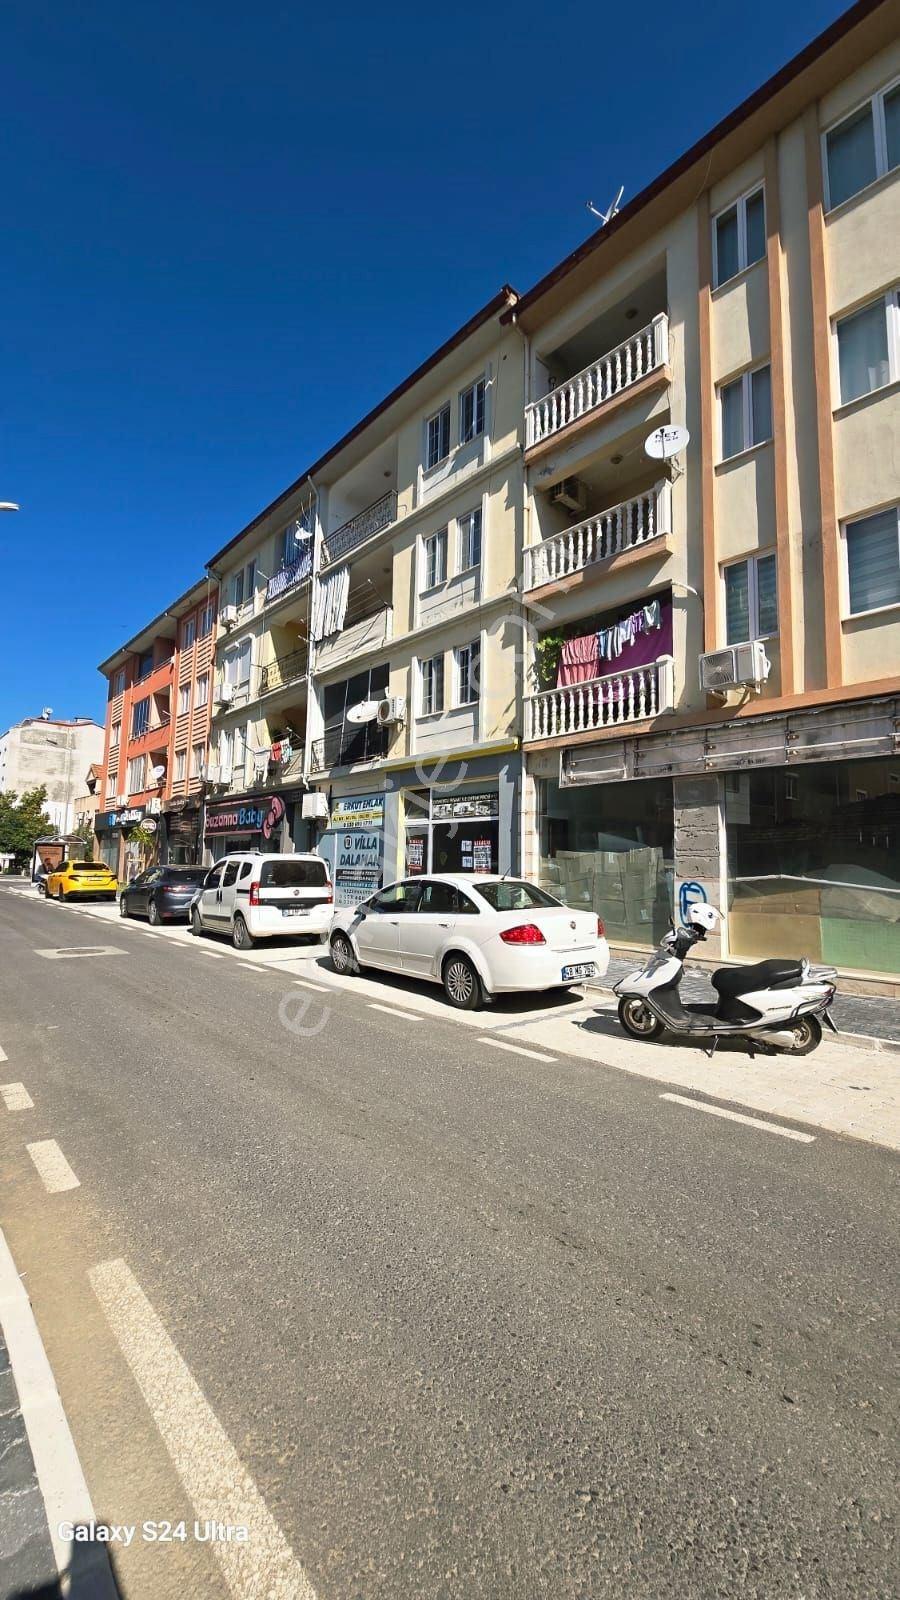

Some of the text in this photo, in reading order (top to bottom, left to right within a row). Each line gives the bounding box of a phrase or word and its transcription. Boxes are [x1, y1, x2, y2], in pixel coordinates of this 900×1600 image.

[344, 797, 384, 811] ERKUT EMLAK
[239, 807, 265, 828] Baby
[355, 834, 377, 850] VİLLA
